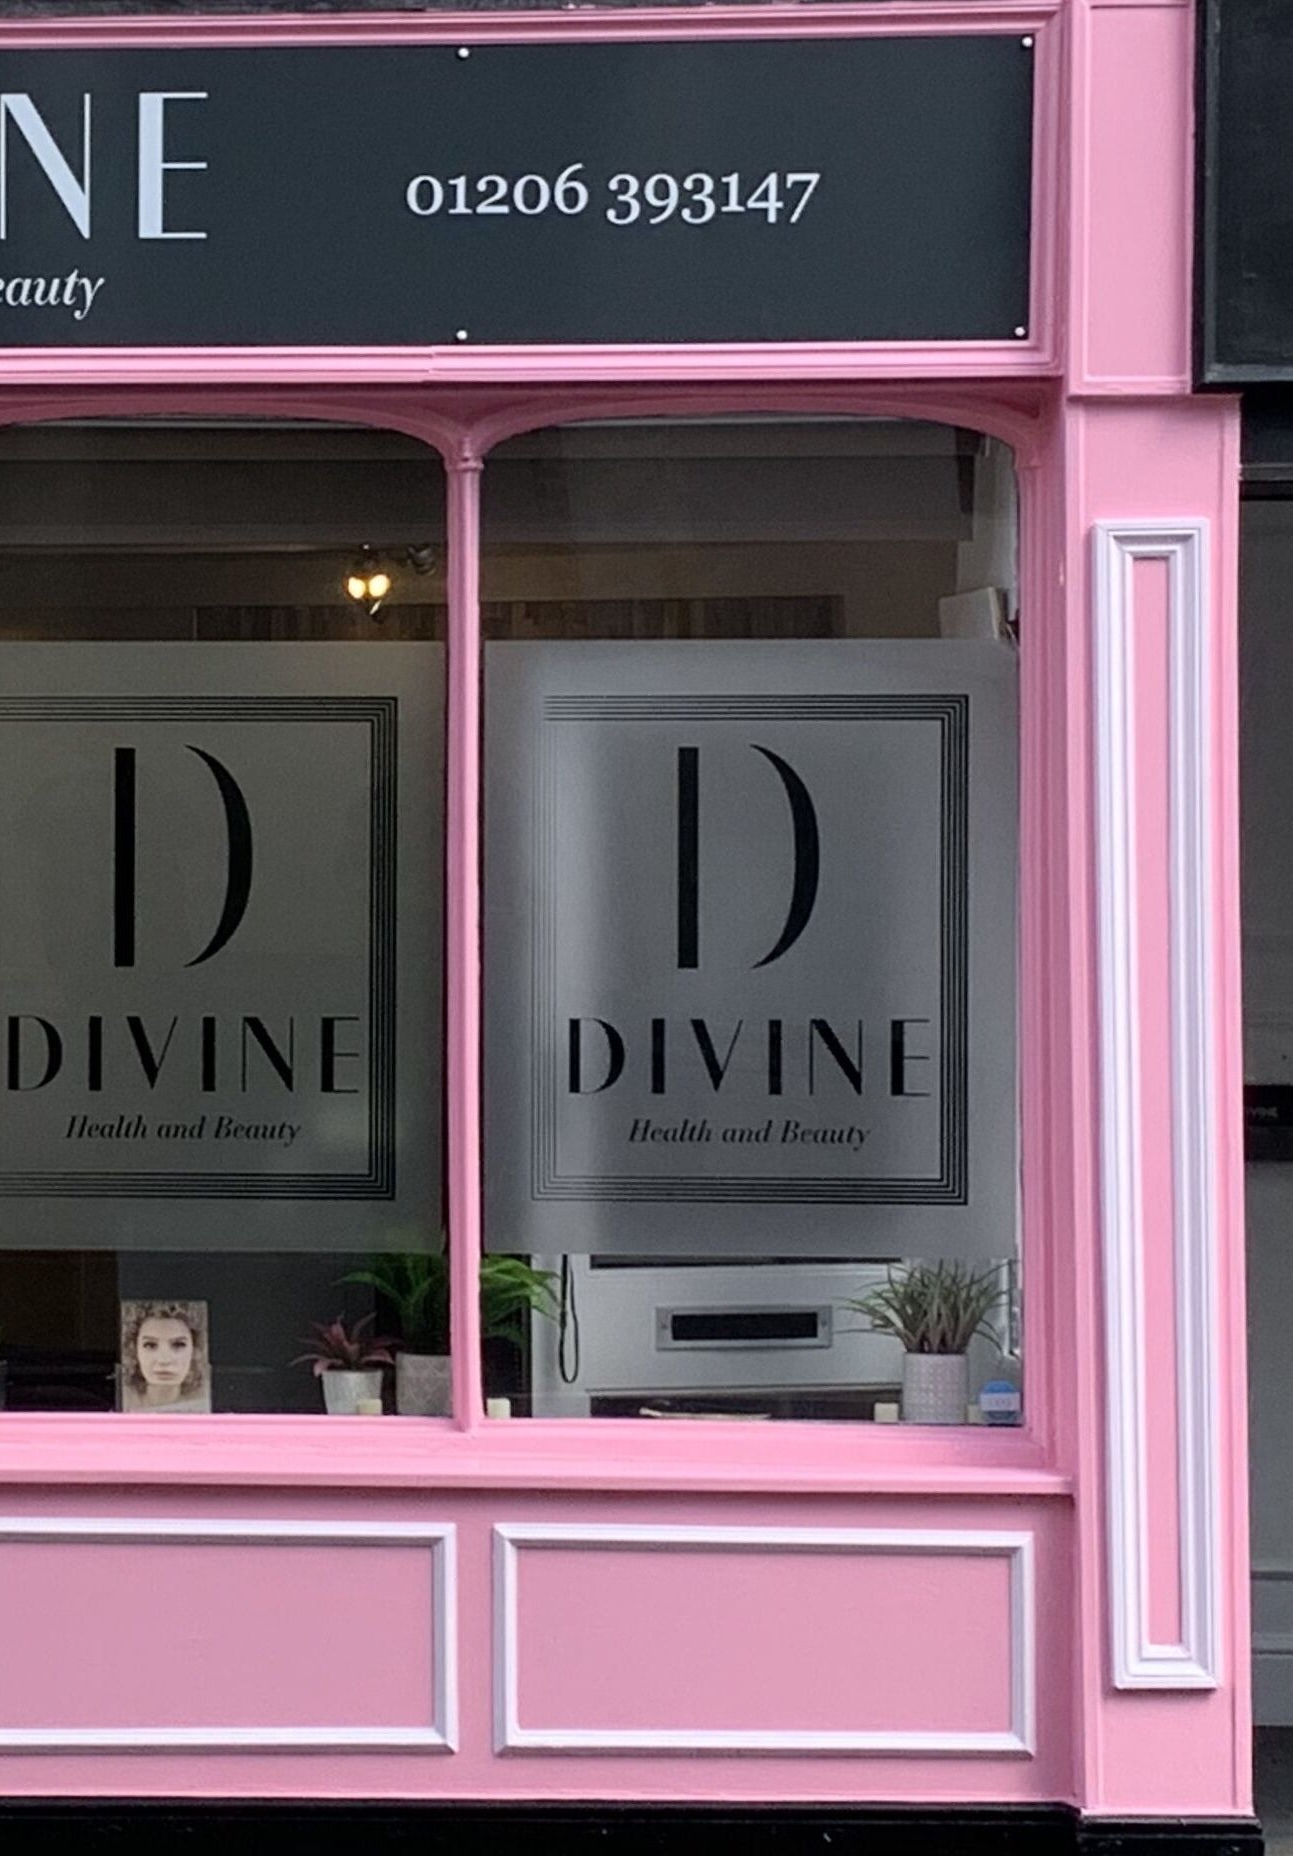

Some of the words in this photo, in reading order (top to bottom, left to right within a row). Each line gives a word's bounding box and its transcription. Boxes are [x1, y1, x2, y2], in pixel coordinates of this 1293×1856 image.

[406, 163, 589, 216] 01206
[606, 172, 821, 226] 393147
[113, 744, 253, 968] D
[677, 744, 820, 970] D
[7, 1015, 360, 1094] DIVINE
[568, 1017, 931, 1097] DIVINE
[65, 1114, 148, 1140] Health
[156, 1115, 206, 1140] and
[213, 1115, 301, 1148] Beauty
[627, 1117, 713, 1144] Health
[721, 1119, 773, 1144] and
[780, 1119, 872, 1152] Beauty
